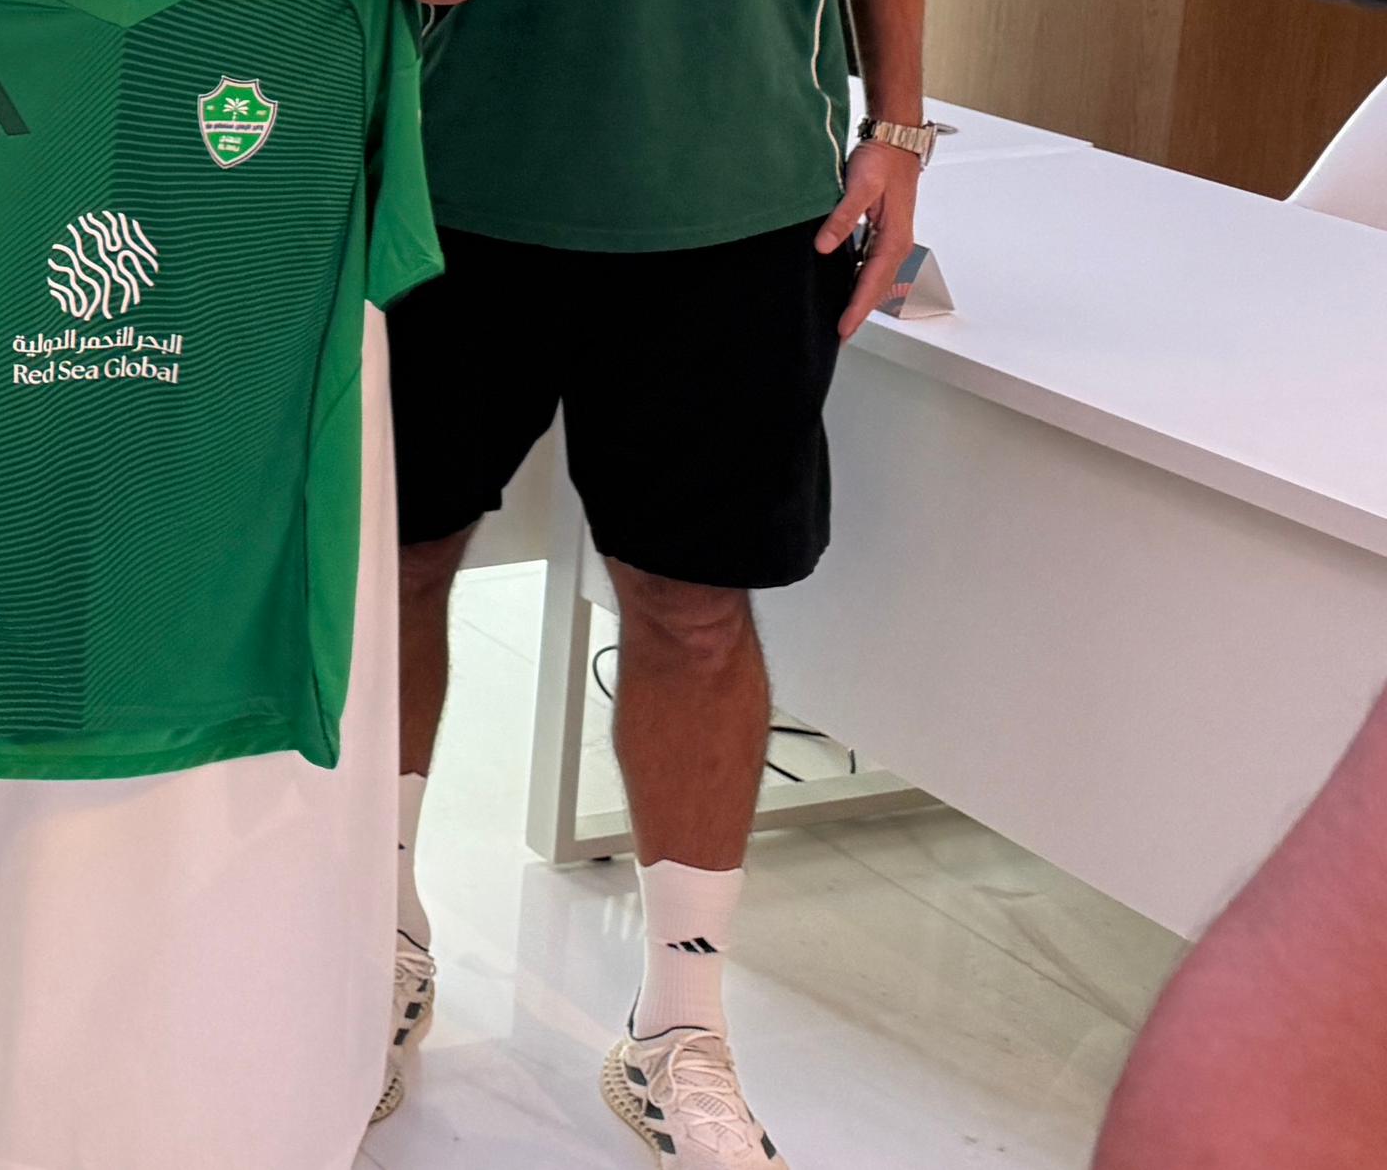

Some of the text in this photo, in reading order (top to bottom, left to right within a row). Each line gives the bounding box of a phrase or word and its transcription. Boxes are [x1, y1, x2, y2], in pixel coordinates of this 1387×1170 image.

[12, 326, 184, 358] البحر الأحمر الدولية
[12, 355, 179, 385] Red Sea Global
